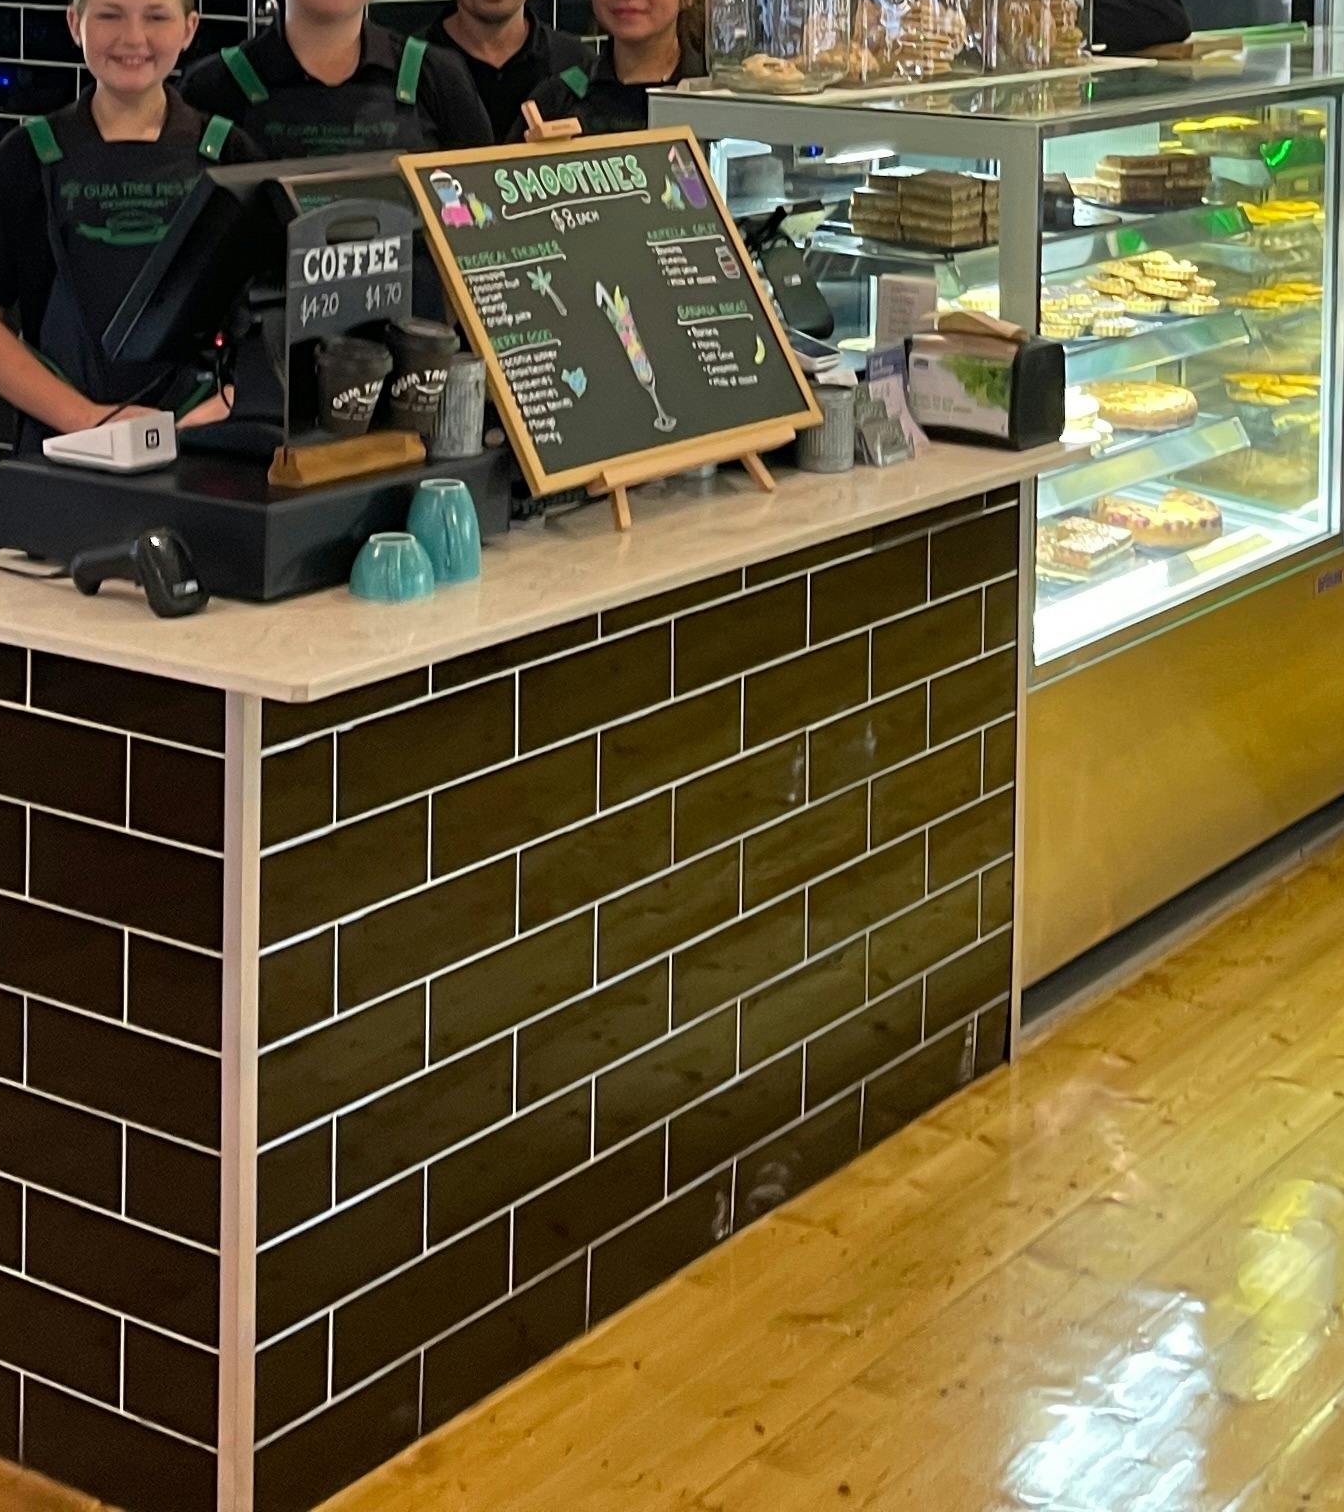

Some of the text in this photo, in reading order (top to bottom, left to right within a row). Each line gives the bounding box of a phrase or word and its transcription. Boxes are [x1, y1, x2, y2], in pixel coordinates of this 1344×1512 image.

[83, 184, 119, 199] GUM
[123, 183, 152, 197] TREE
[494, 154, 648, 204] SMOOTHIES
[550, 207, 600, 235] $8 EACH
[303, 237, 401, 284] COFFEE
[457, 250, 511, 269] TROPICAL
[391, 372, 420, 396] GUM
[332, 386, 360, 410] GUM
